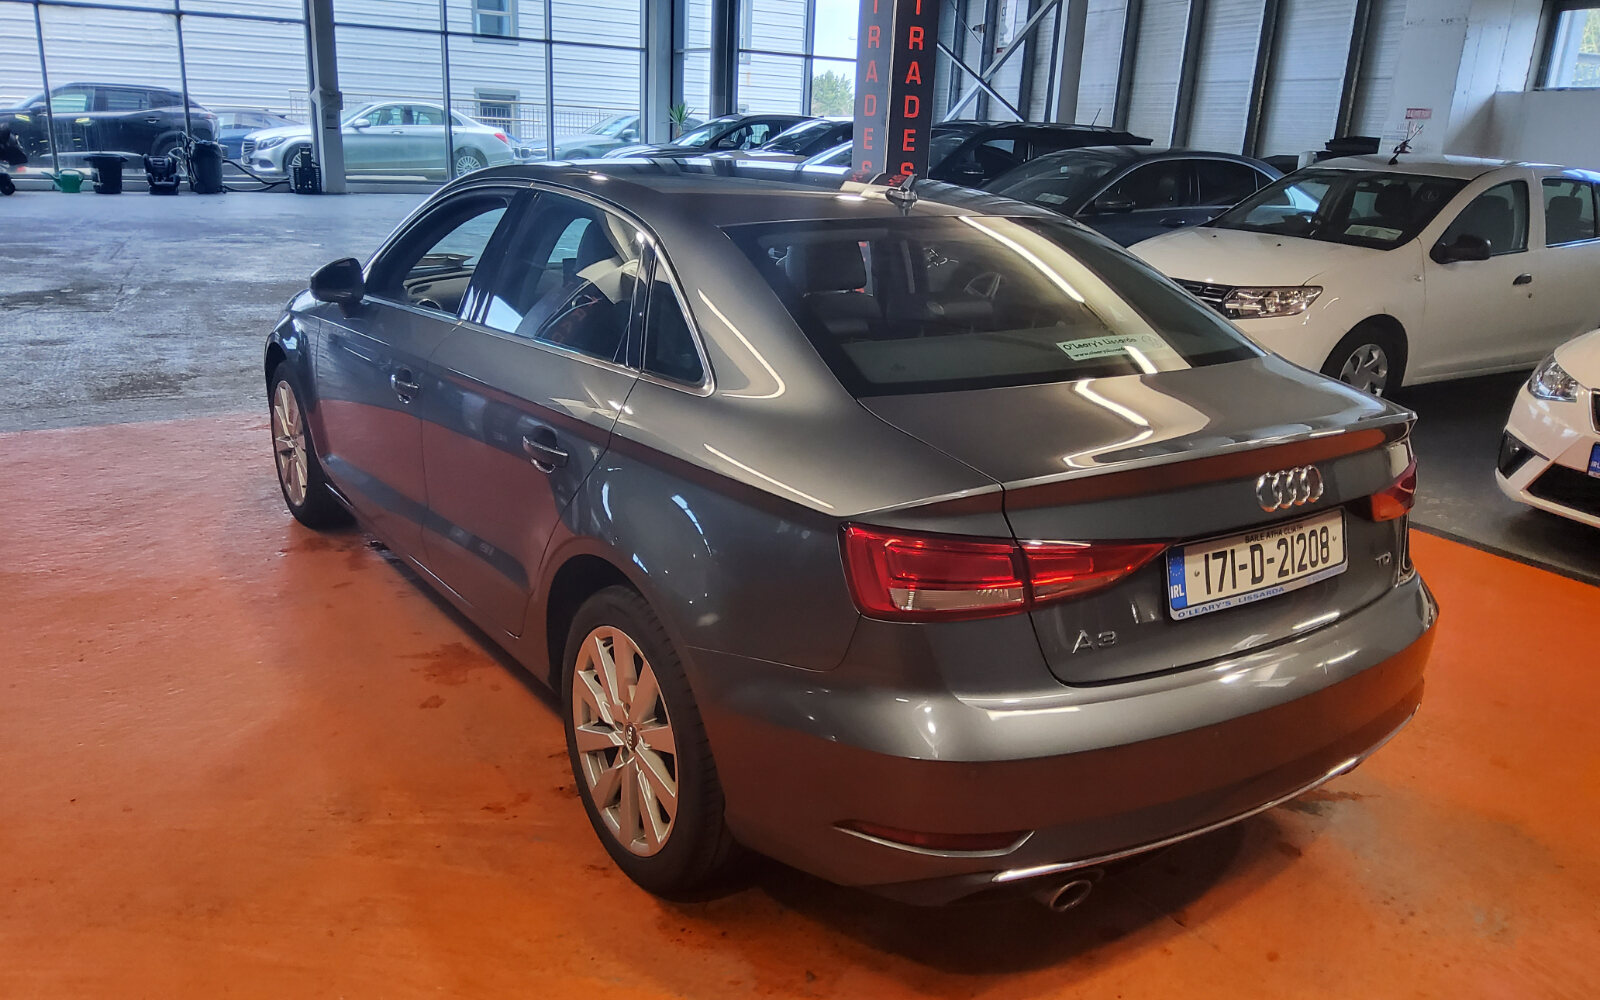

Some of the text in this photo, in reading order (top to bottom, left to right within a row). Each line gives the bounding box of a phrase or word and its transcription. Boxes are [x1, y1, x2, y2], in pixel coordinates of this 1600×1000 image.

[1204, 525, 1329, 595] 171-D-21208
[1170, 584, 1185, 599] IRL
[1178, 586, 1285, 618] O'LEARY'S LISSARDA
[1072, 630, 1116, 654] A3
